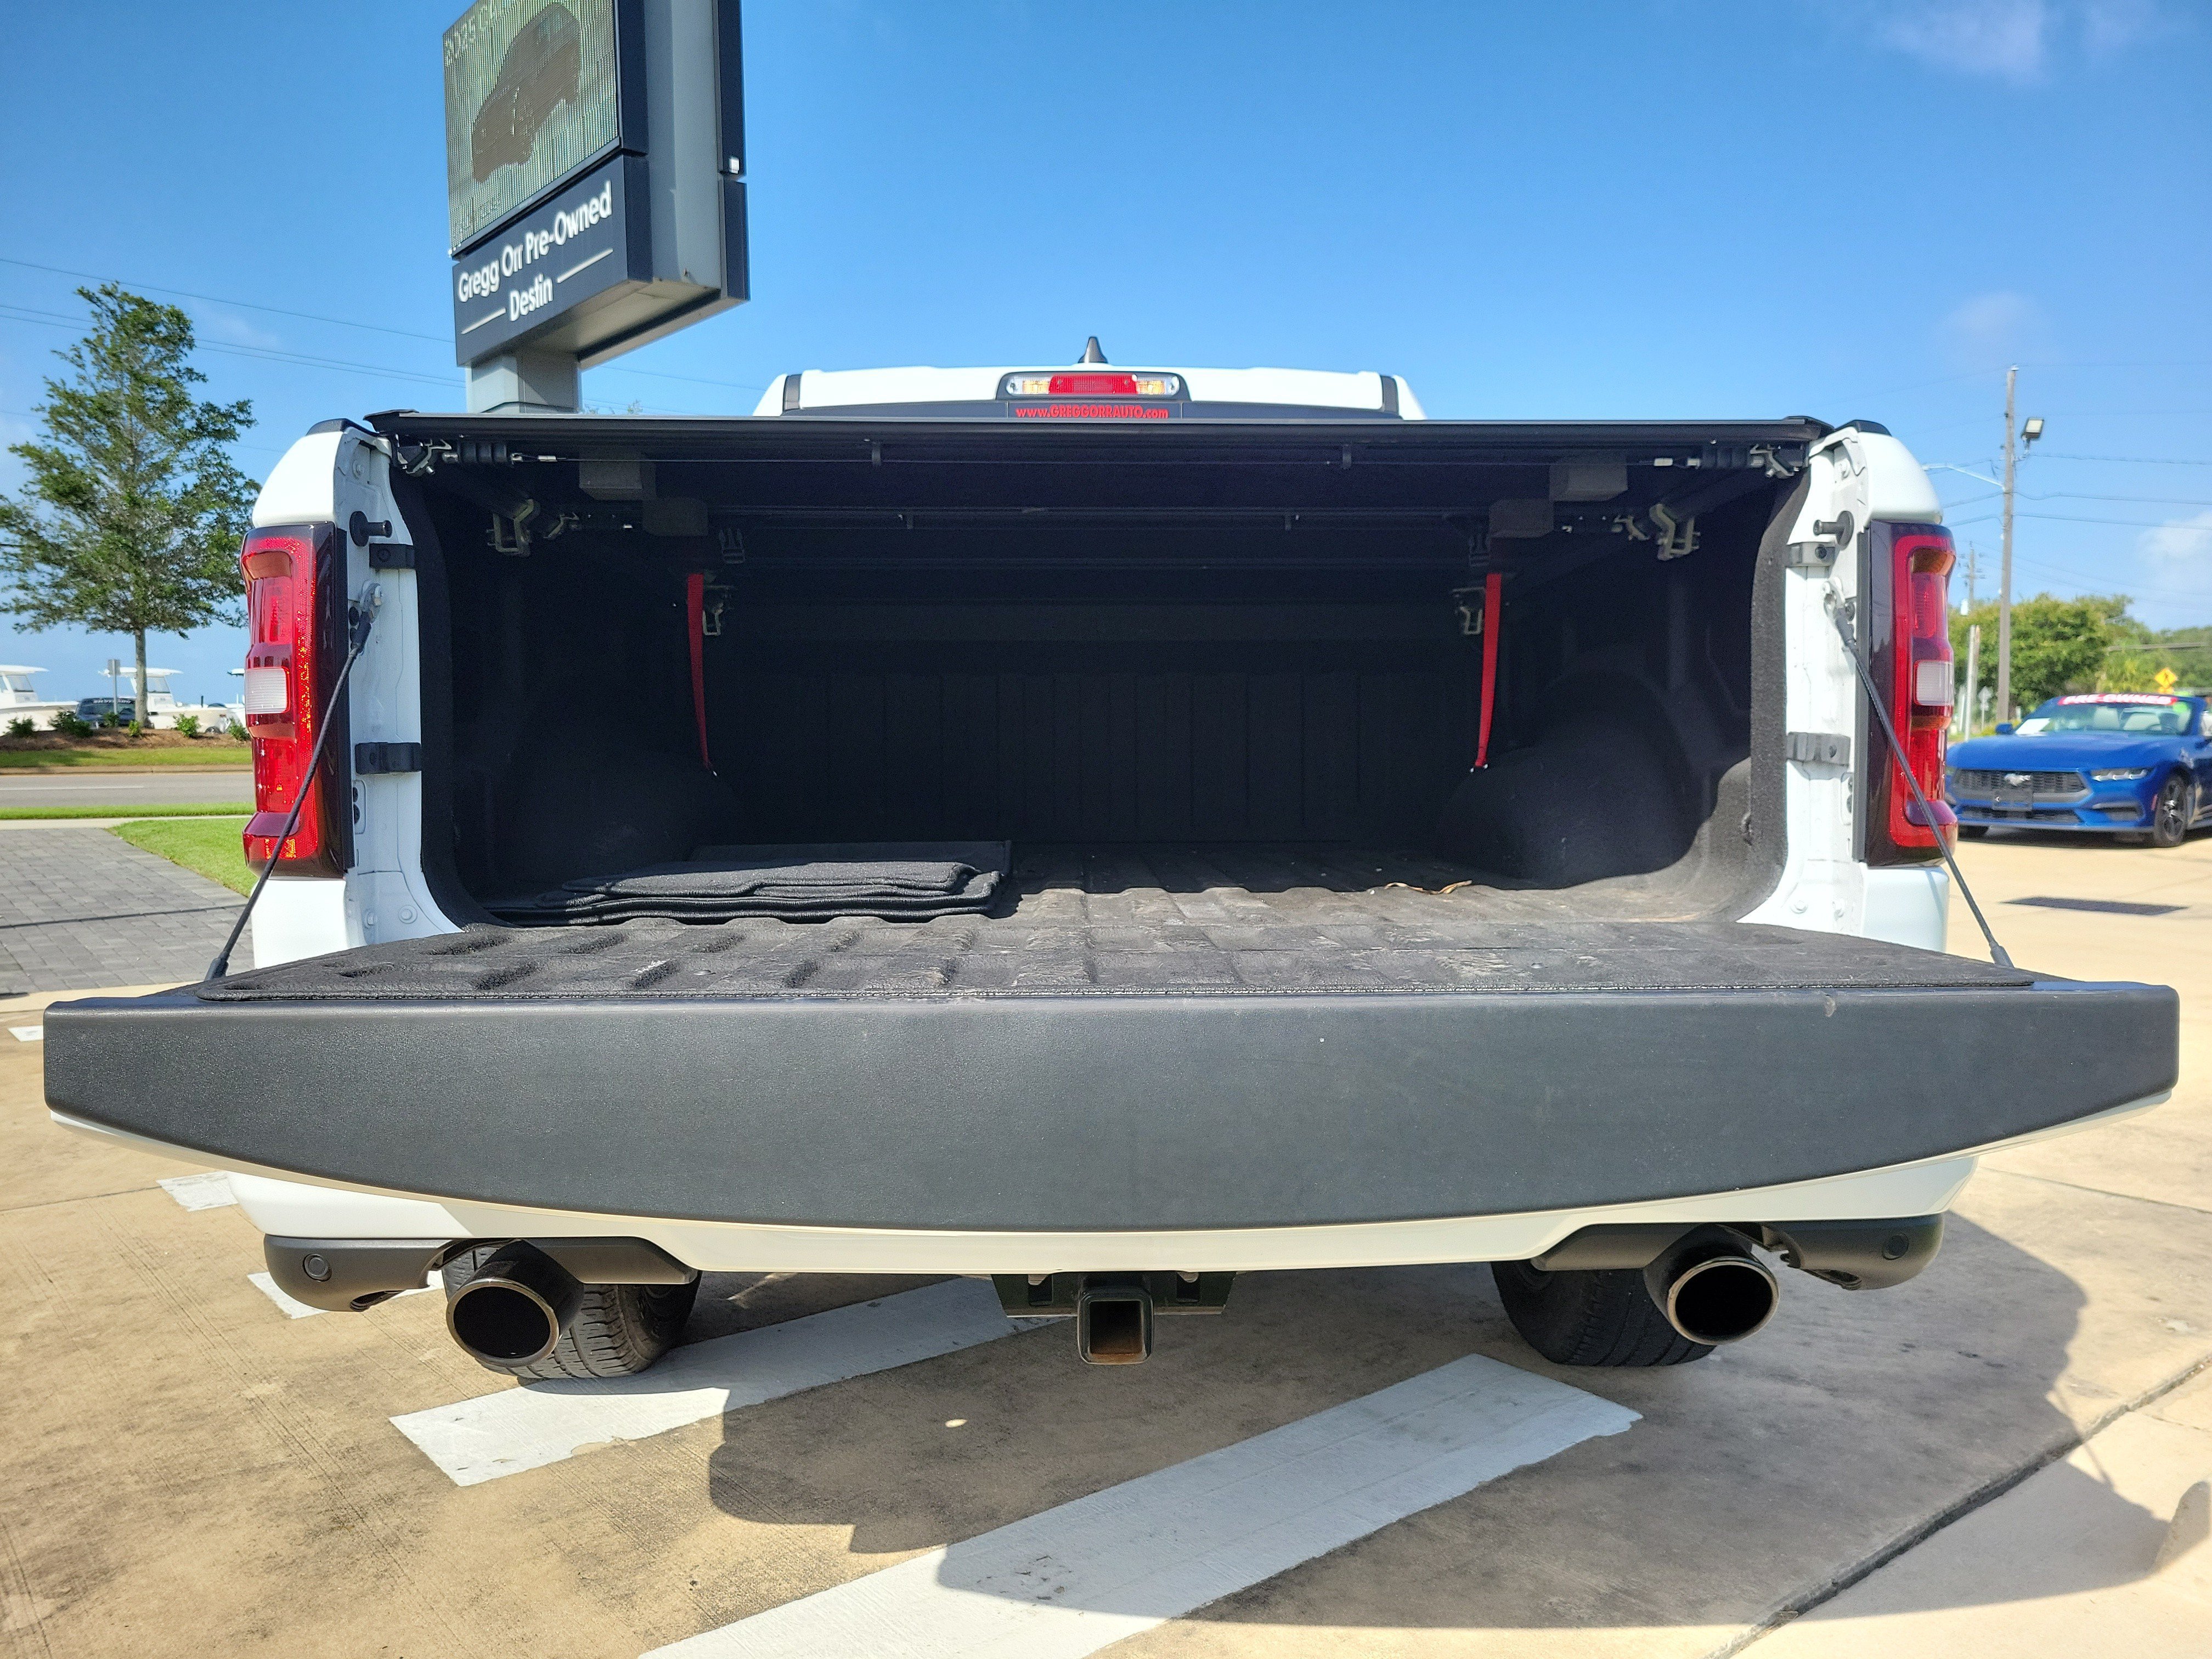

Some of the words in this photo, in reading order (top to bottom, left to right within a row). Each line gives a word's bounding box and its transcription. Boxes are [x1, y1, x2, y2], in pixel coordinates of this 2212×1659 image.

[459, 259, 500, 302] Gregg
[501, 245, 523, 277] Orr
[525, 180, 612, 264] Pre-Owned
[510, 274, 553, 321] Destin
[1016, 404, 1169, 419] www.GREGGORRAUTO.com
